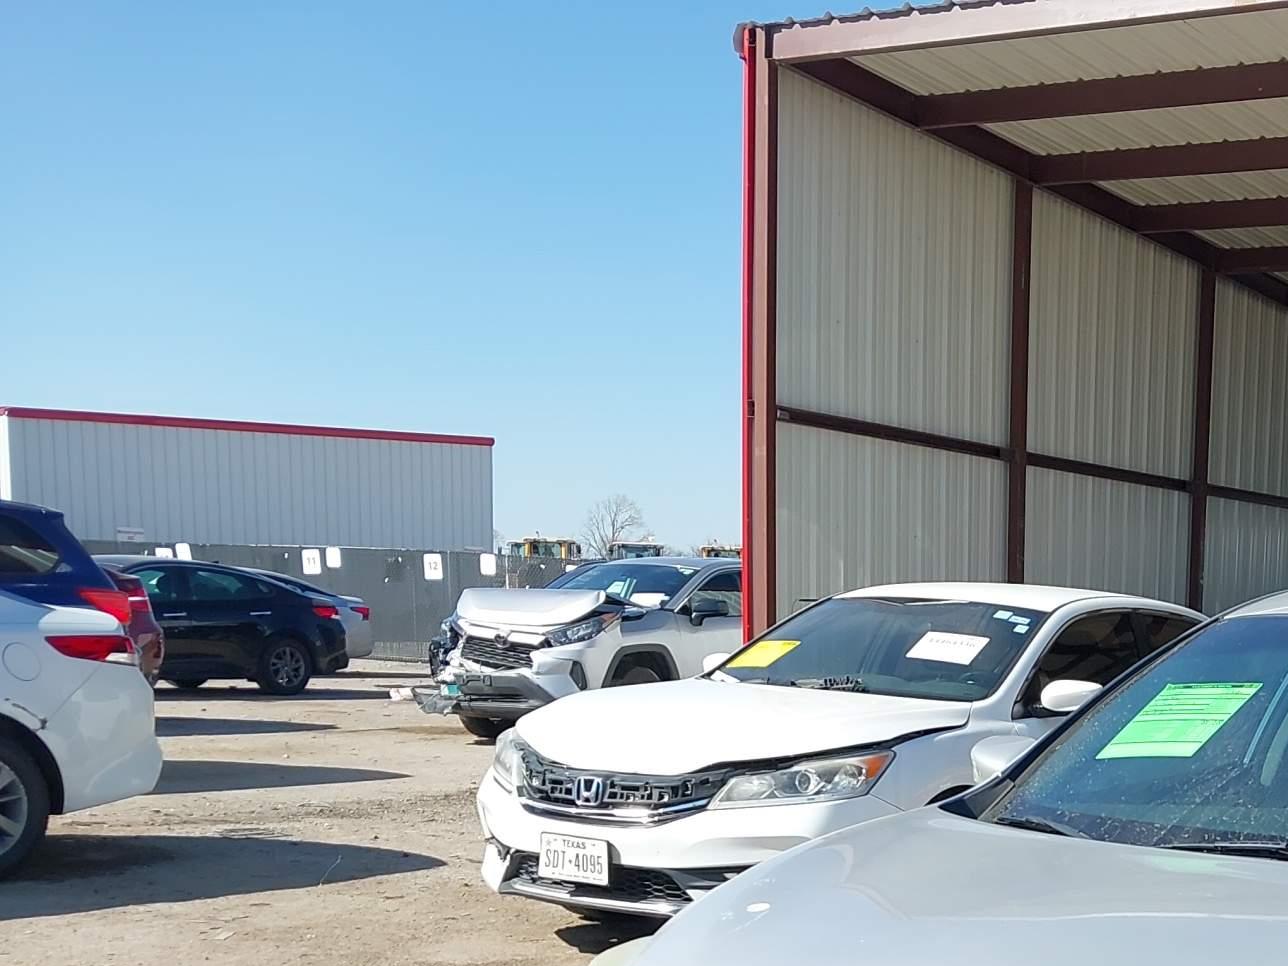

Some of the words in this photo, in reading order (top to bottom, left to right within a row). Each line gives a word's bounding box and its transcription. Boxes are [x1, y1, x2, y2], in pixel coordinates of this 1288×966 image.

[306, 556, 317, 567] 11
[428, 561, 439, 571] 12
[563, 839, 587, 850] TEXAS
